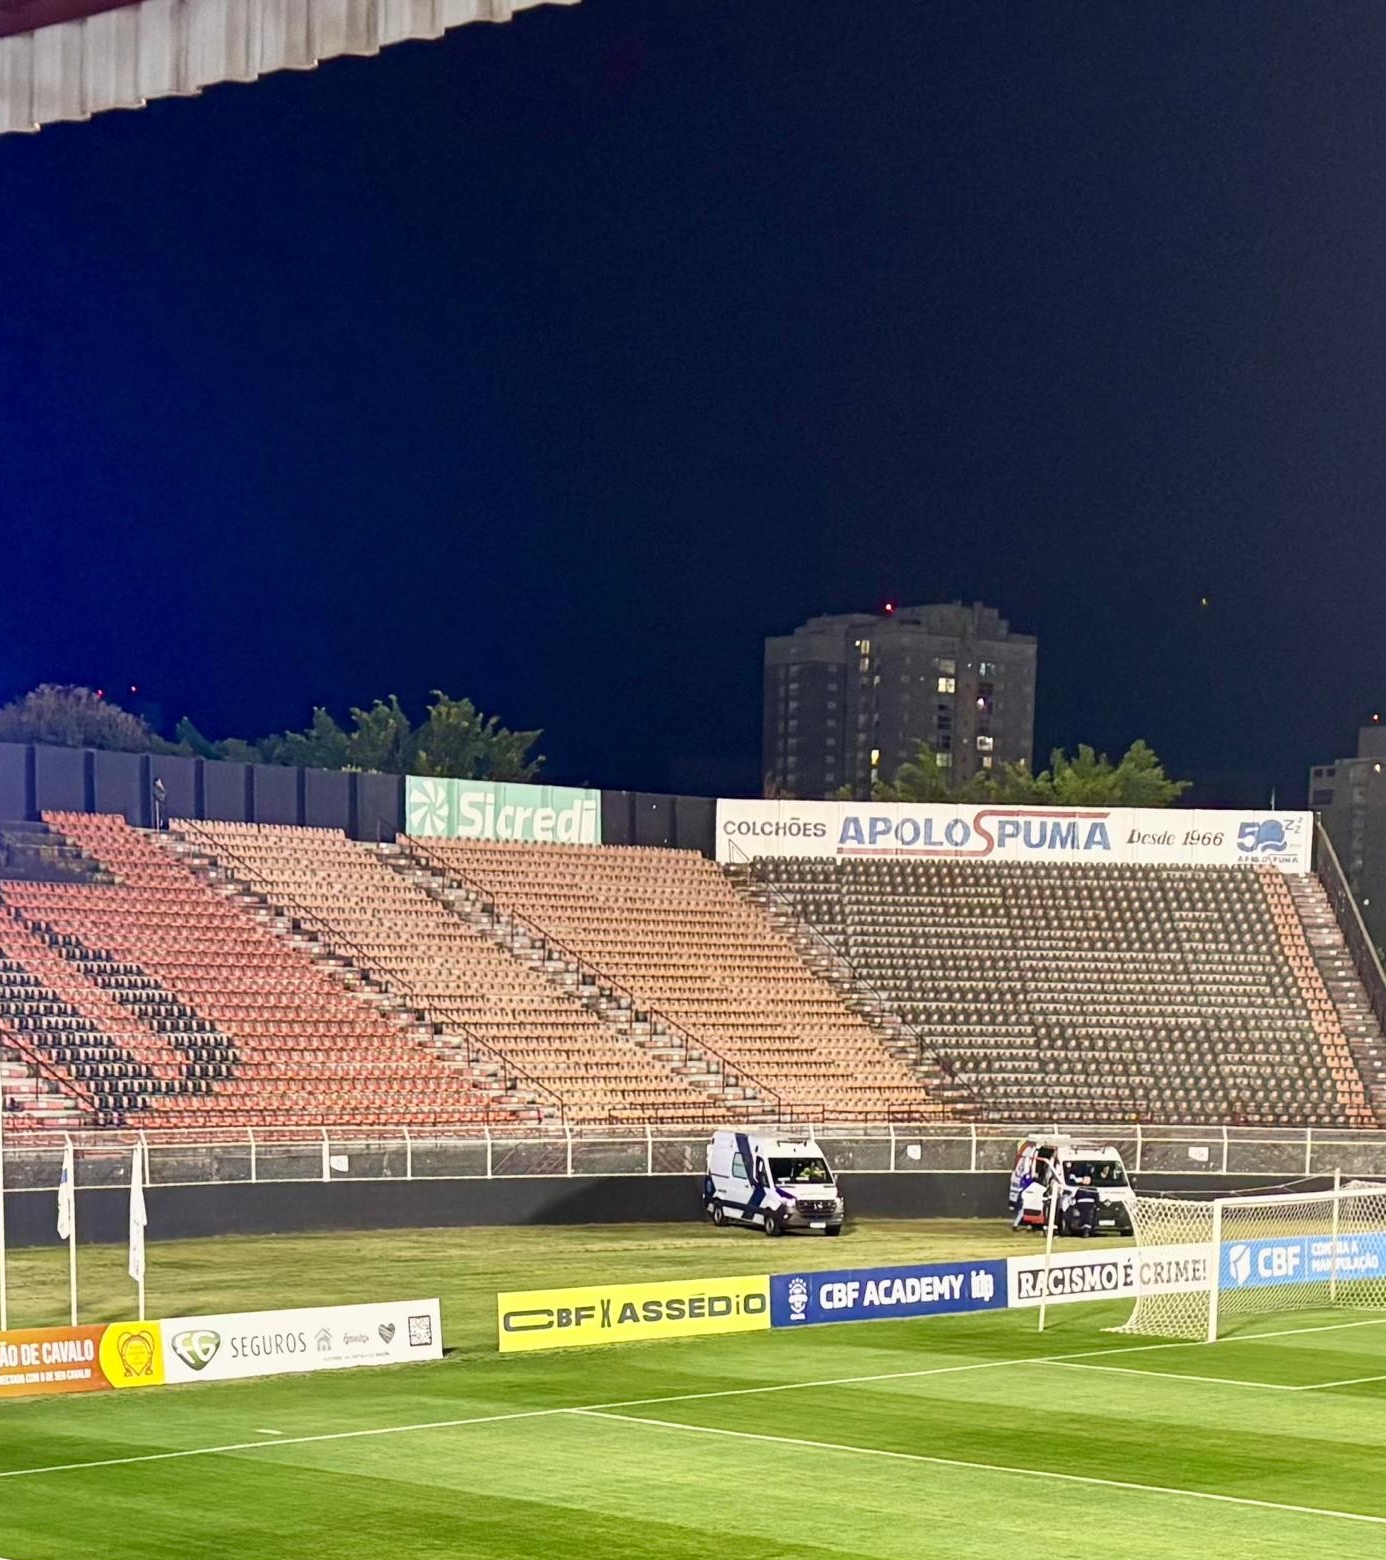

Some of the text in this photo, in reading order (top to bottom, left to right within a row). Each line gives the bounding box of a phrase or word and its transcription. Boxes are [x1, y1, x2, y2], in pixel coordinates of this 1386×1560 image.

[458, 792, 596, 842] Sicredi
[723, 818, 827, 838] COLCHÕES
[1127, 828, 1176, 847] Desde
[1182, 831, 1224, 847] 1966
[1258, 1246, 1301, 1277] CBF
[819, 1281, 860, 1310] CBF
[863, 1274, 964, 1306] ACADEMY
[1018, 1258, 1207, 1299] RACISMO É CRIME!
[503, 1305, 596, 1333] CBF
[20, 1344, 40, 1366] DE
[42, 1339, 95, 1366] CAVALO
[230, 1332, 308, 1358] SEGUROS
